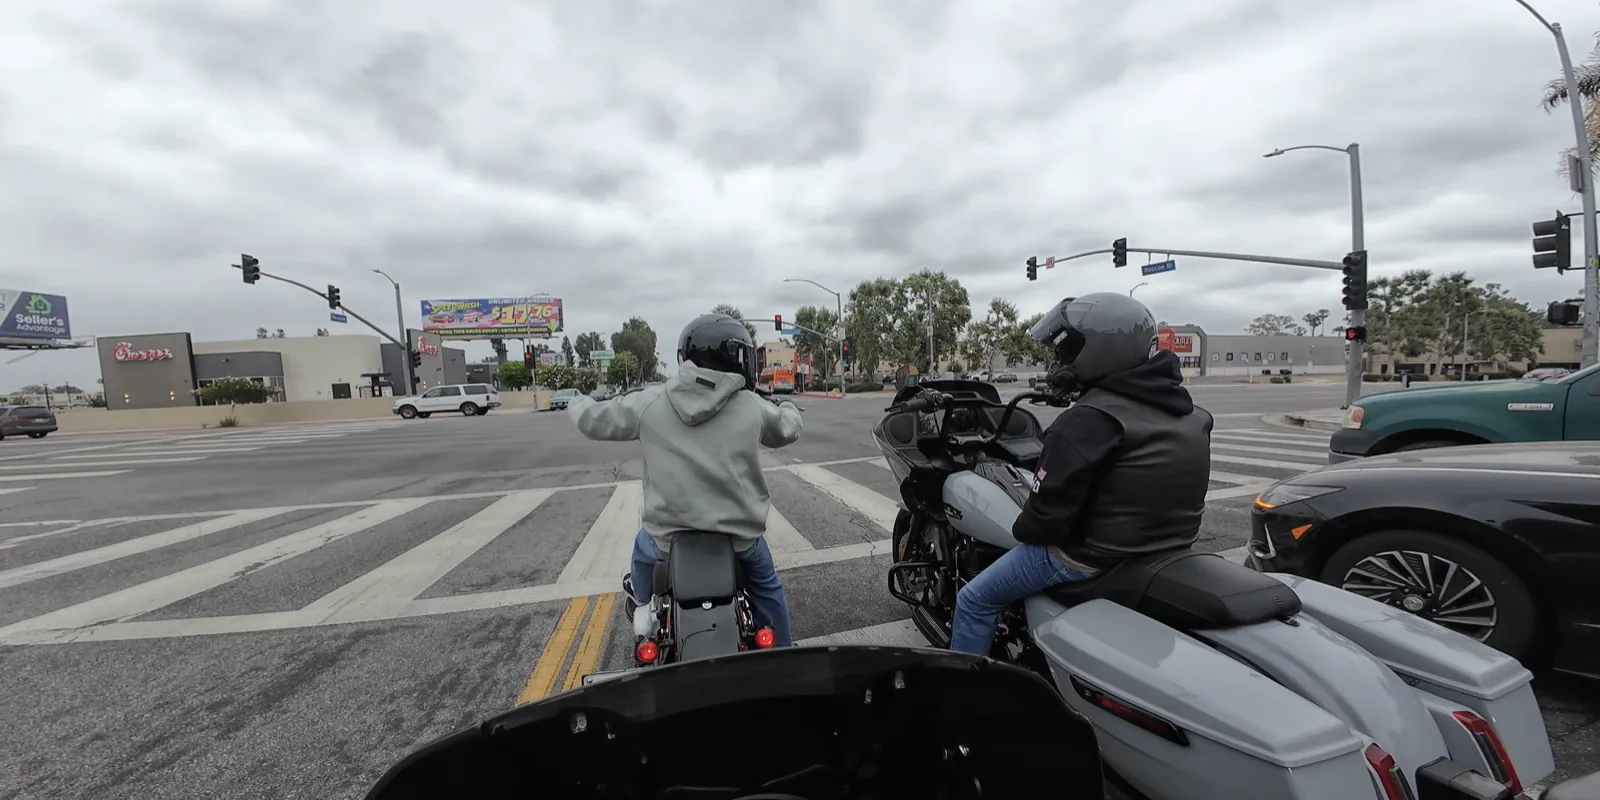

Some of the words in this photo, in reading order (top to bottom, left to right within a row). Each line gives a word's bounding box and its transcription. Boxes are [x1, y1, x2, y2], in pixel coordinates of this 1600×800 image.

[1144, 264, 1165, 273] Roscoe
[15, 313, 65, 327] Seller's
[16, 323, 66, 334] Advantage
[1174, 337, 1193, 345] OUTLET
